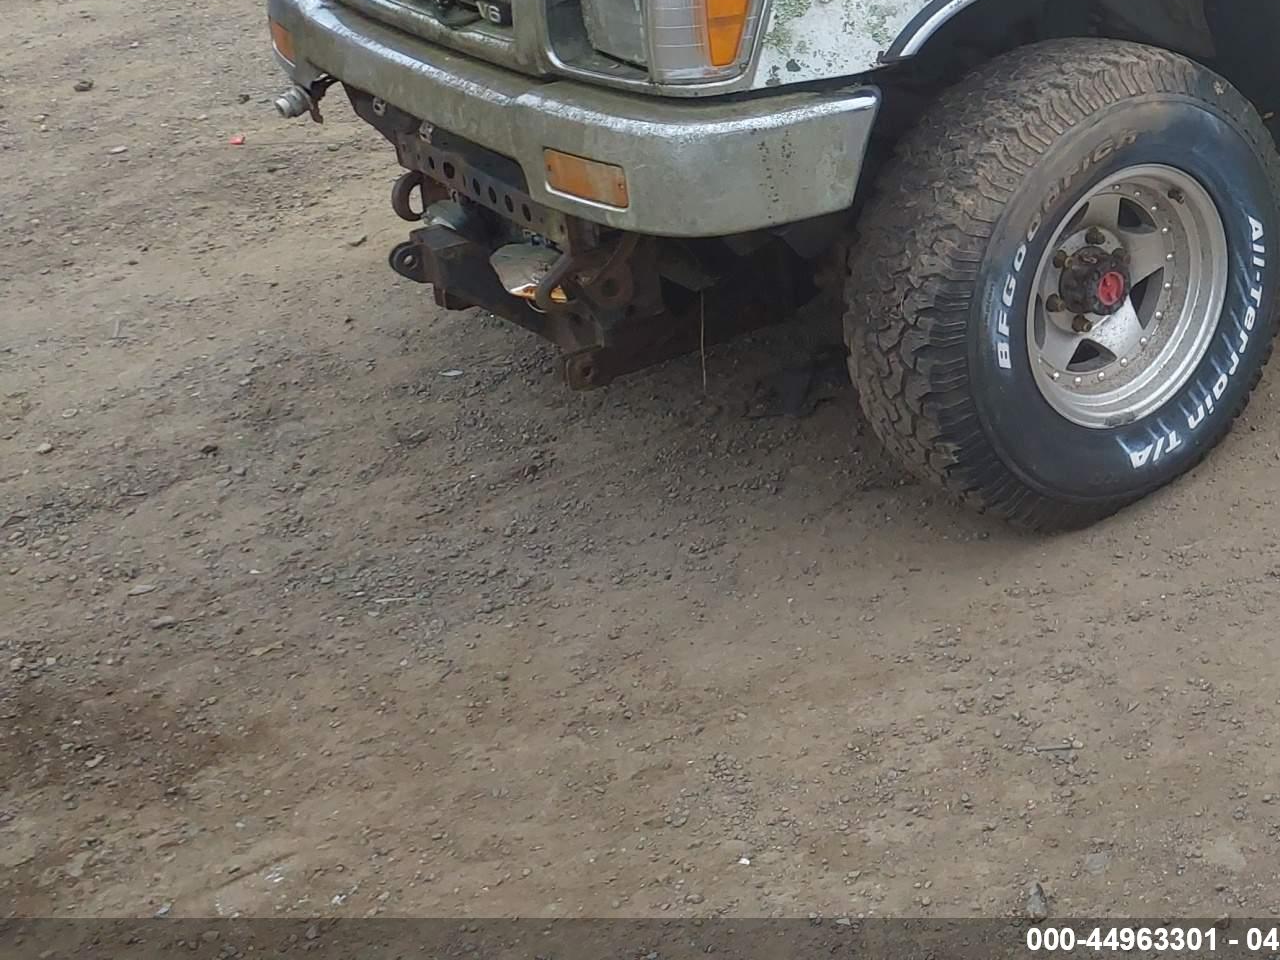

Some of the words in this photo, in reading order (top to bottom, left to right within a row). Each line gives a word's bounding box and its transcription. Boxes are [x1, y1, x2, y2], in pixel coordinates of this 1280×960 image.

[476, 1, 501, 23] V6
[1188, 215, 1265, 430] All-Terrain
[1129, 430, 1182, 469] T/A
